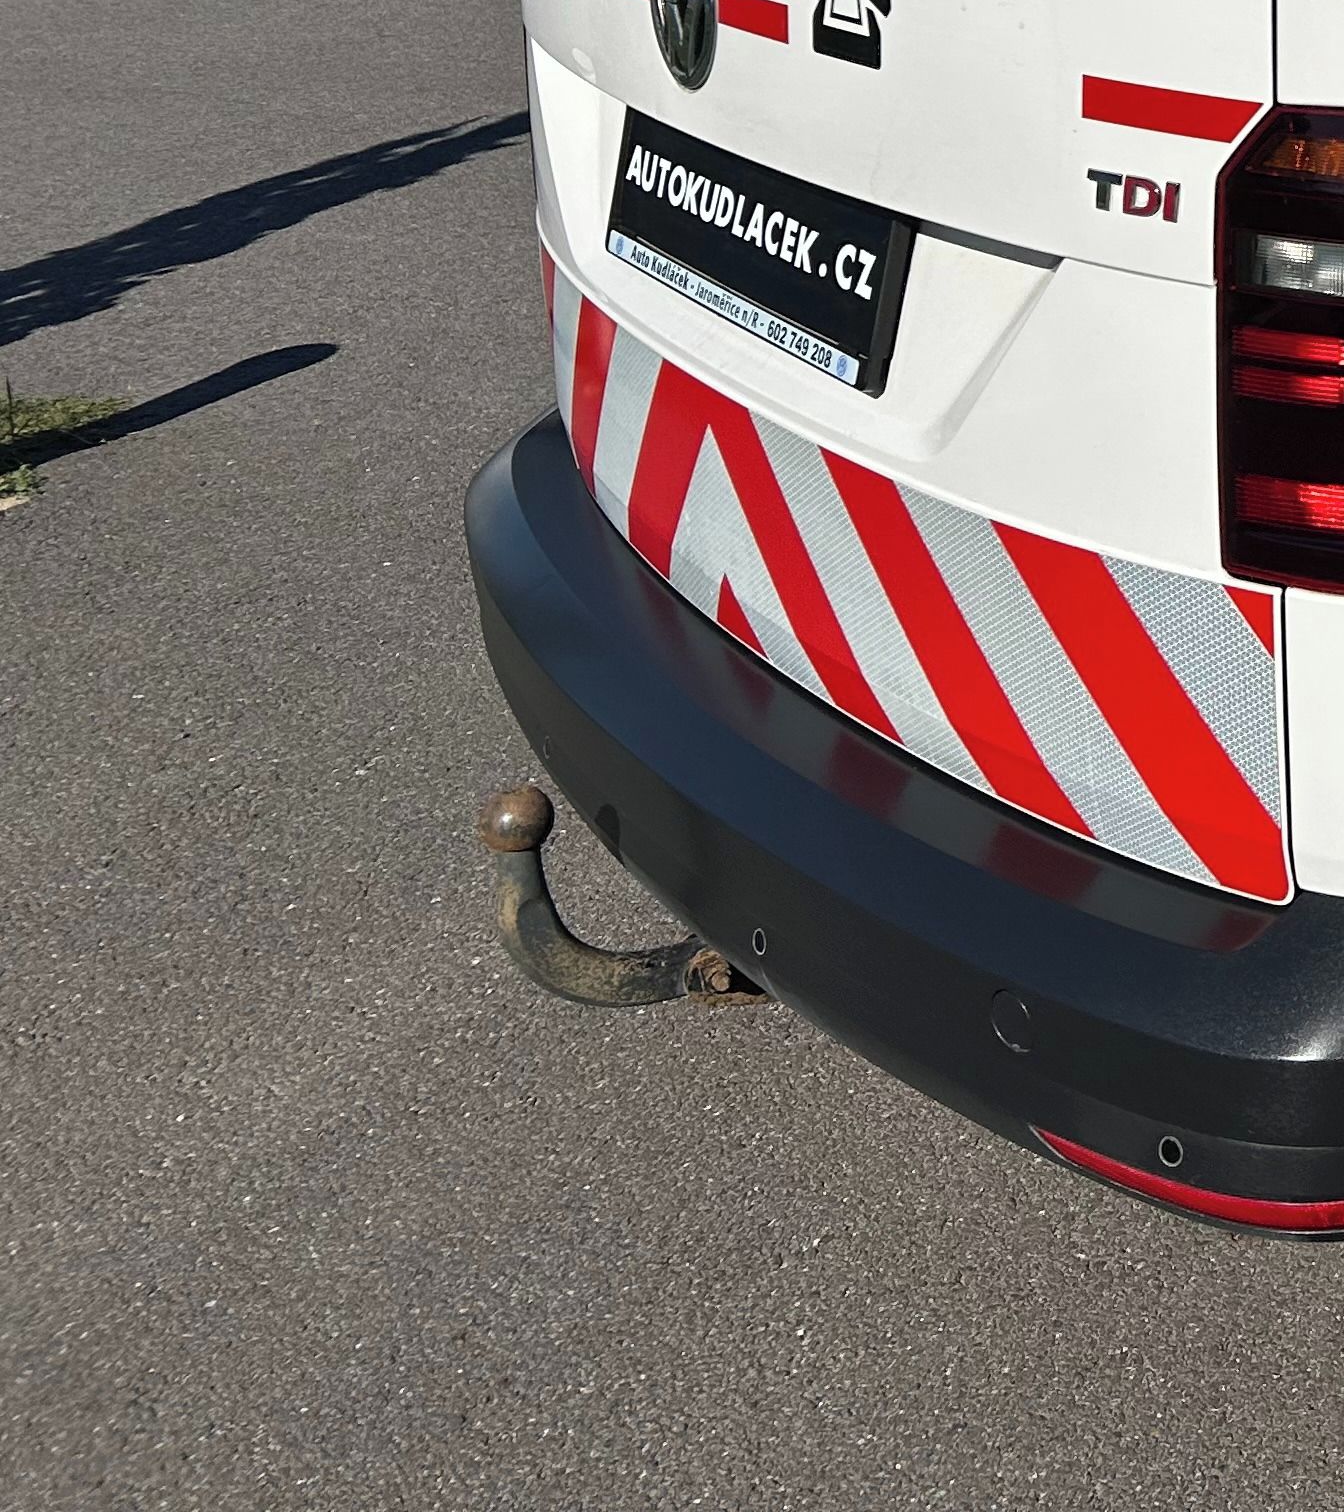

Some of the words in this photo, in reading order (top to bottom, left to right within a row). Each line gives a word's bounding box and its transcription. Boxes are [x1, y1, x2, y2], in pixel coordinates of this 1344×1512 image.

[625, 144, 877, 300] AUTOKUDLACEK.CZ
[1087, 168, 1182, 223] TDI
[630, 245, 650, 268] Auto
[767, 321, 788, 345] 602
[789, 332, 810, 356] 749
[811, 344, 832, 368] 208
